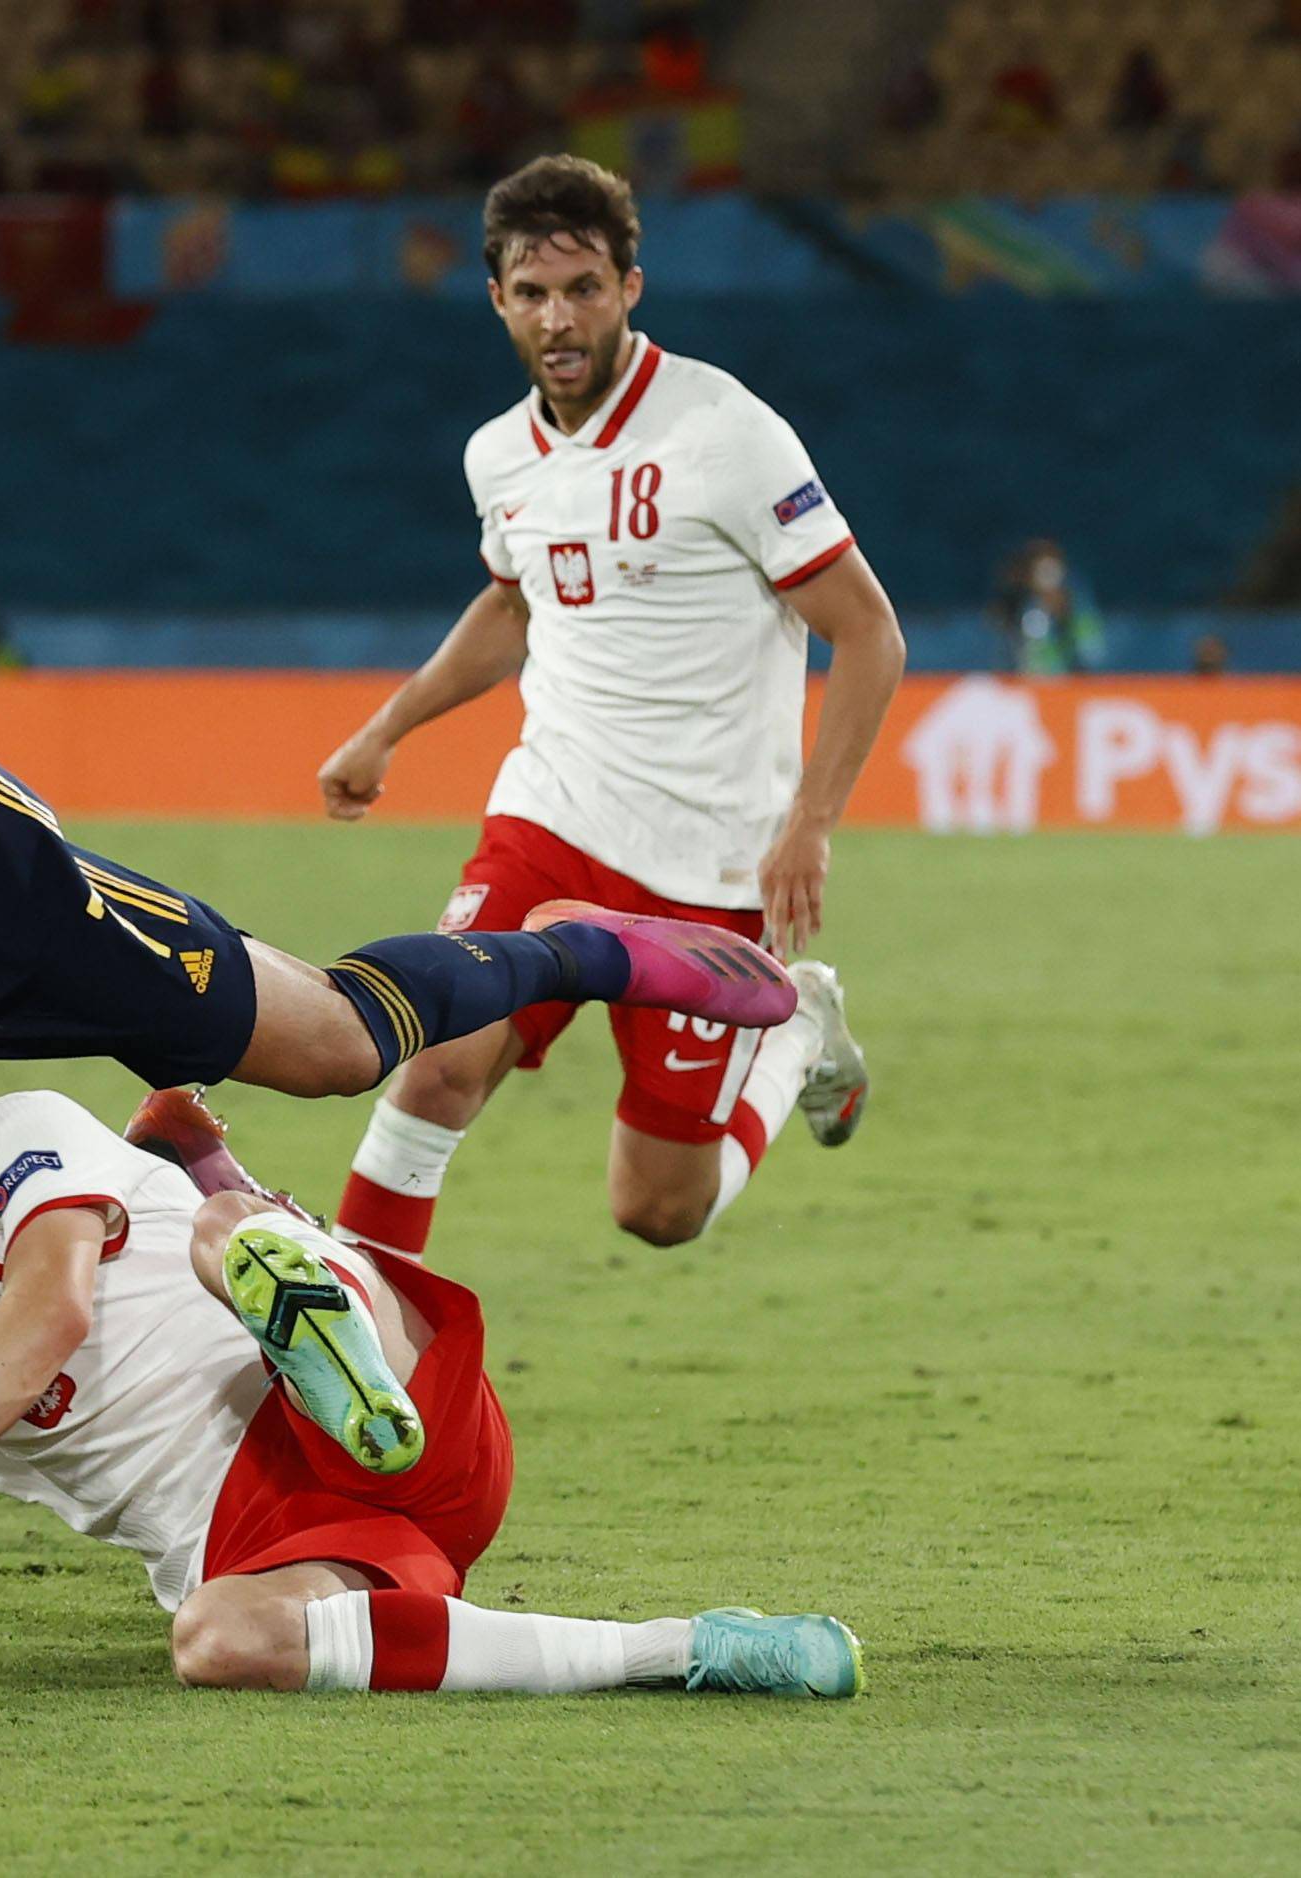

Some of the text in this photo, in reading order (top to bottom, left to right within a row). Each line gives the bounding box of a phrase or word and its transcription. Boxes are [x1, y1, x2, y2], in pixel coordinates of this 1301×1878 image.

[609, 462, 663, 541] 18
[1078, 699, 1301, 835] Pys
[196, 948, 215, 994] adidas
[2, 1154, 60, 1191] RESPECT
